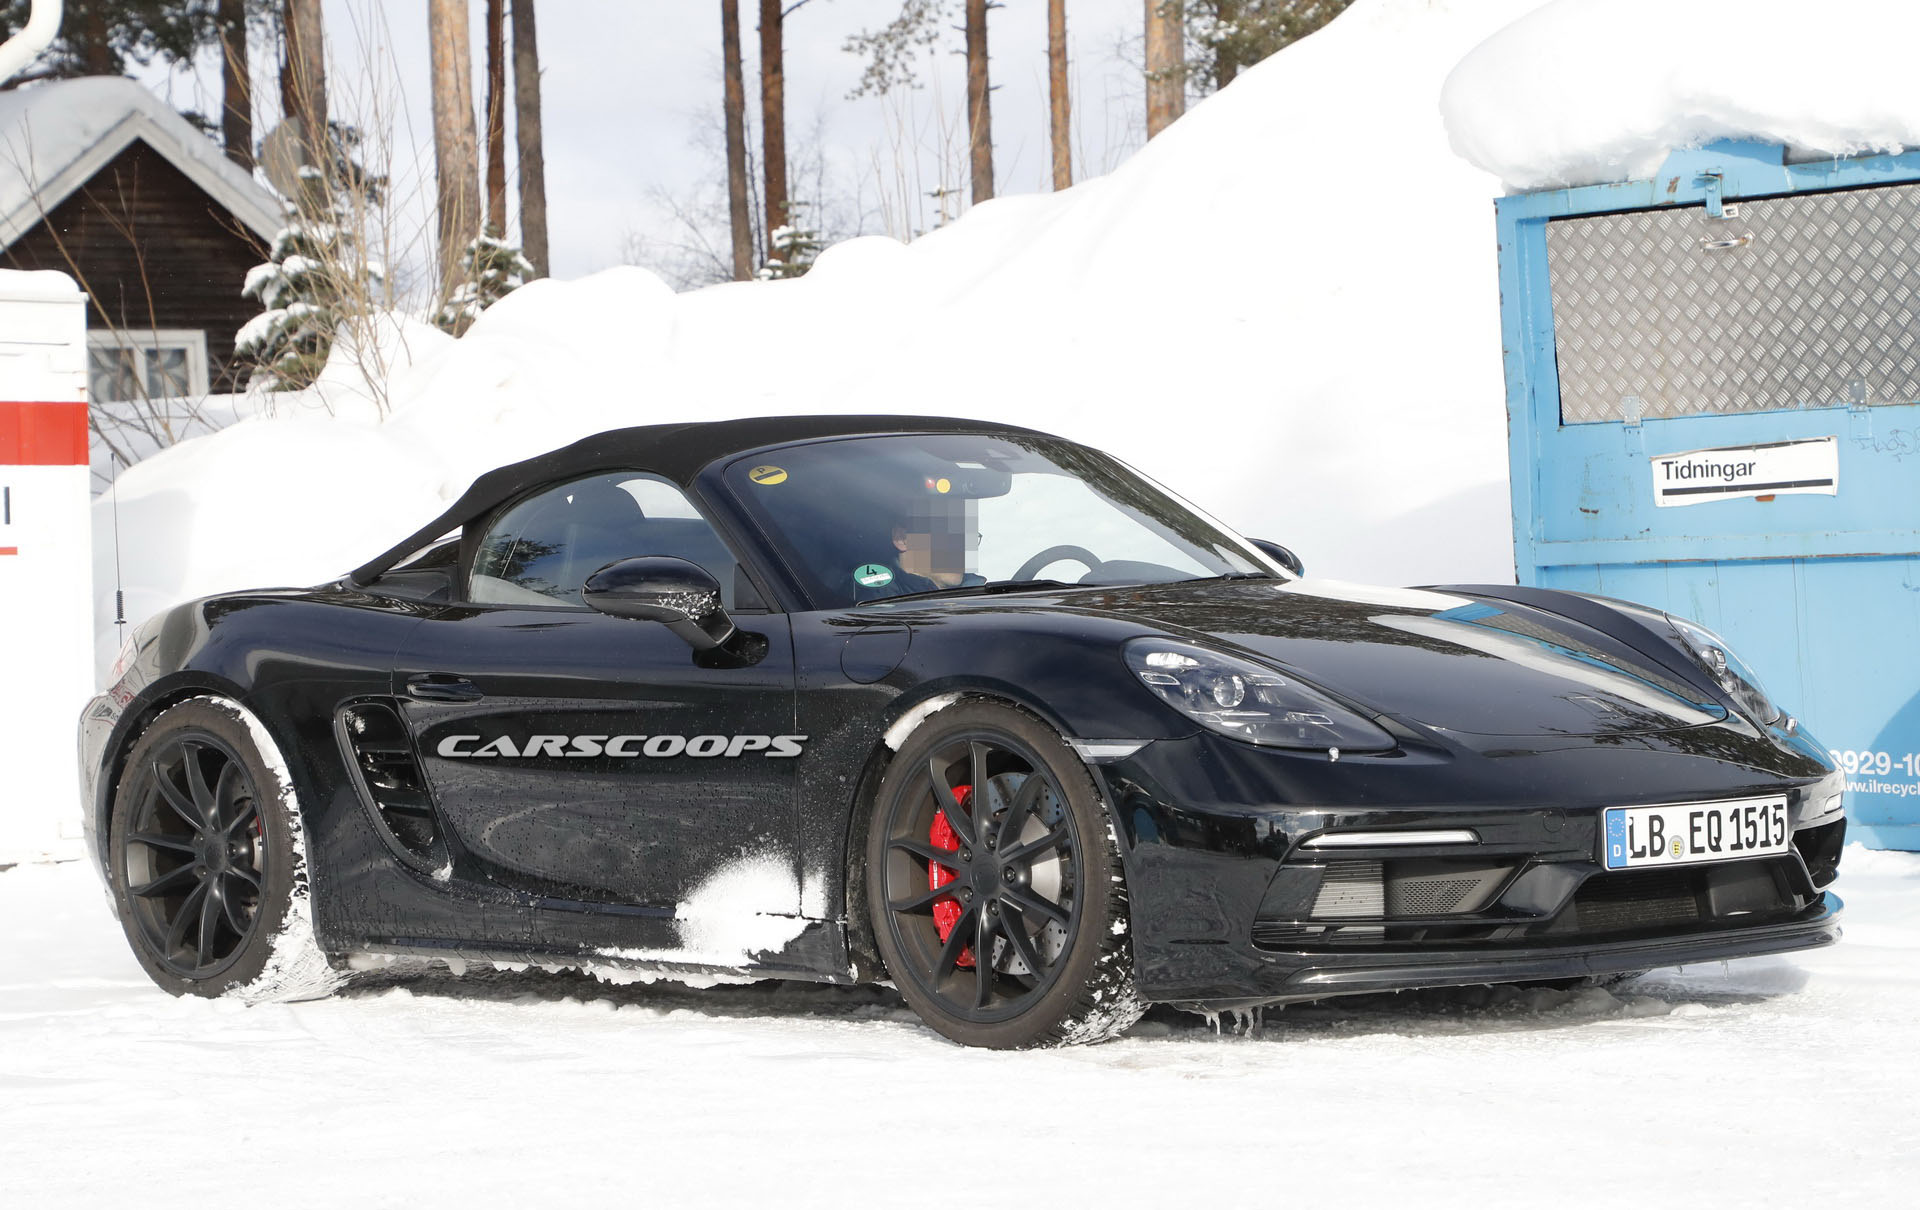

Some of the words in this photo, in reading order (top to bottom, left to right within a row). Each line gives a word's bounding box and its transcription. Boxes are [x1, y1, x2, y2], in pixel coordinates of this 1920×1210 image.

[1661, 459, 1756, 482] Tidningar
[866, 565, 878, 575] 4
[1629, 814, 1666, 859] LB
[1689, 810, 1723, 854] EQ
[1729, 804, 1785, 851] 1515
[1613, 844, 1622, 858] D
